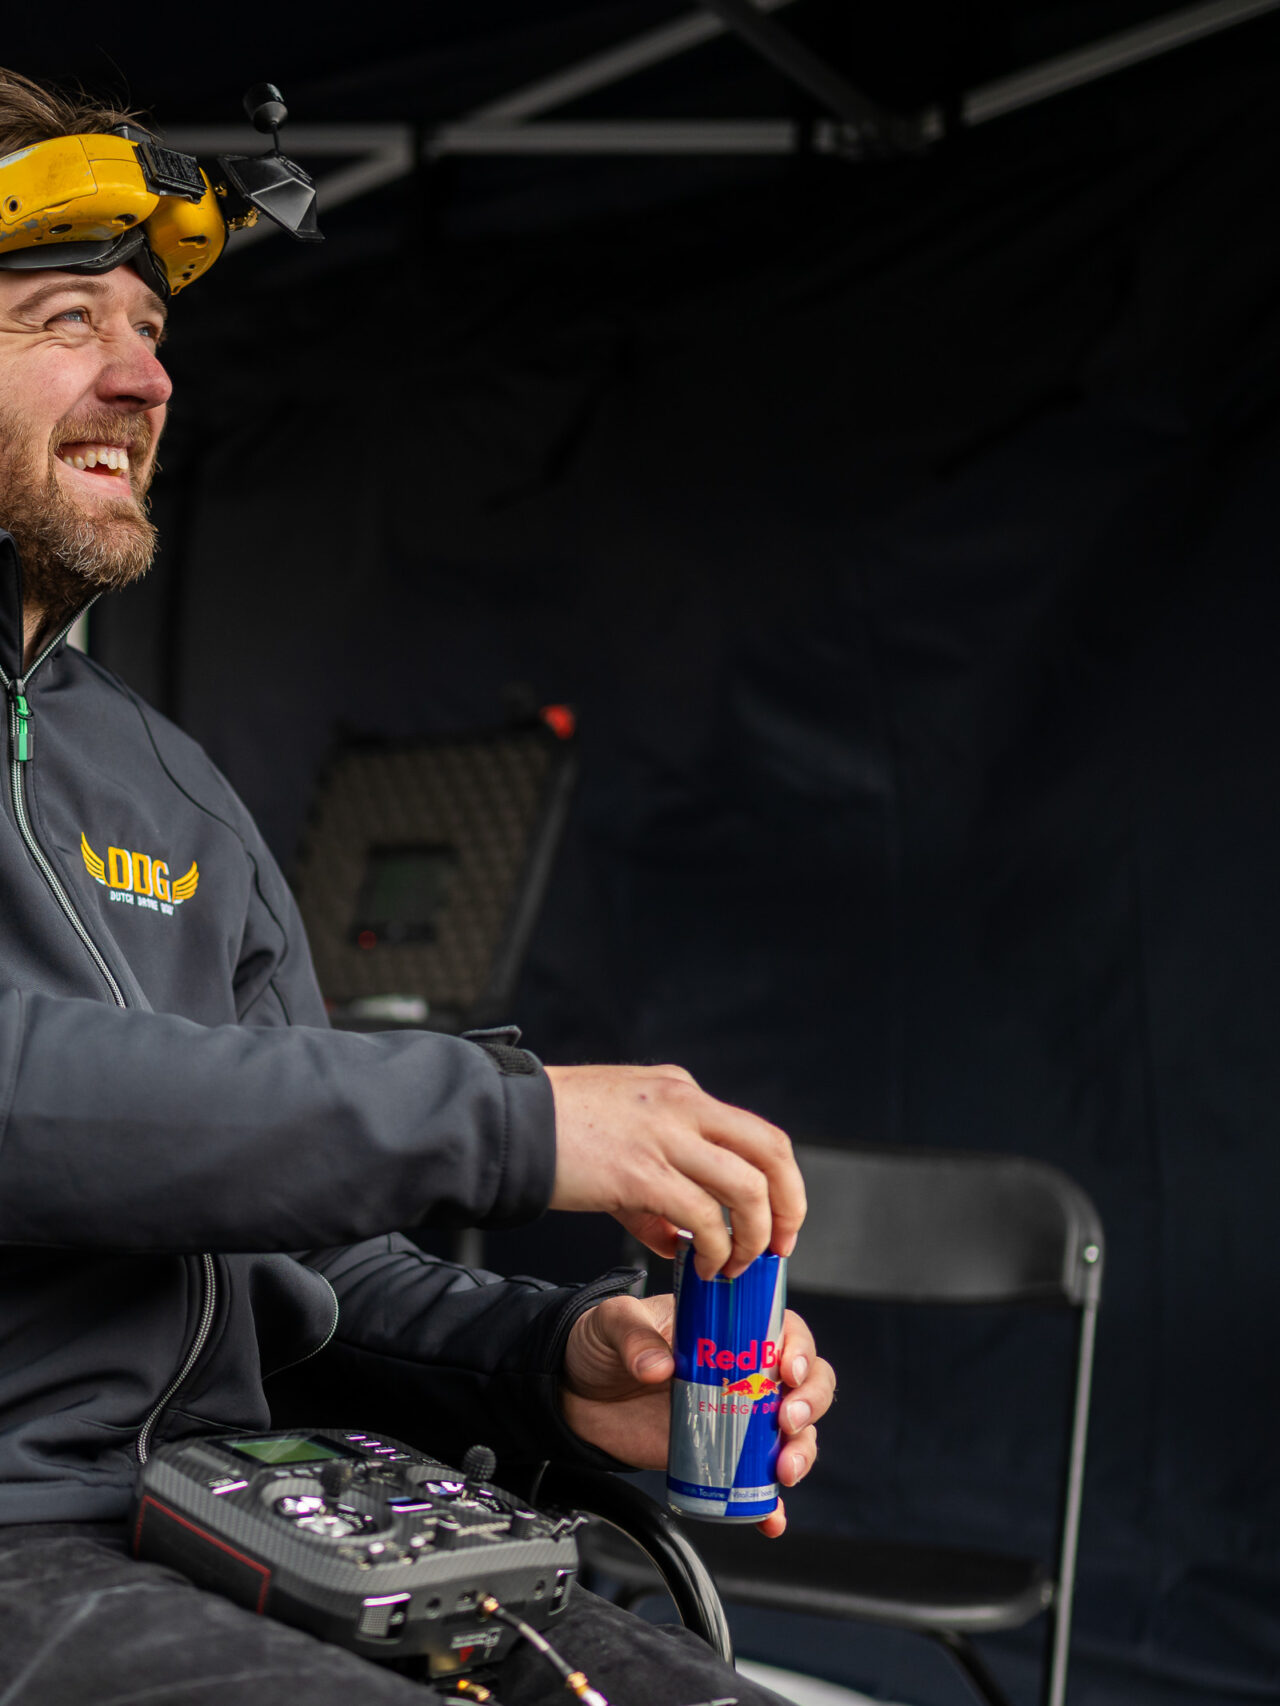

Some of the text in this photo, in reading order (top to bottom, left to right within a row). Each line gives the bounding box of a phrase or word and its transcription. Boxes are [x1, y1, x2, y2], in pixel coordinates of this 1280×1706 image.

[108, 846, 171, 903] DDG
[110, 890, 134, 905] DUTCH
[696, 1337, 757, 1371] Red
[698, 1401, 759, 1415] ENERGY
